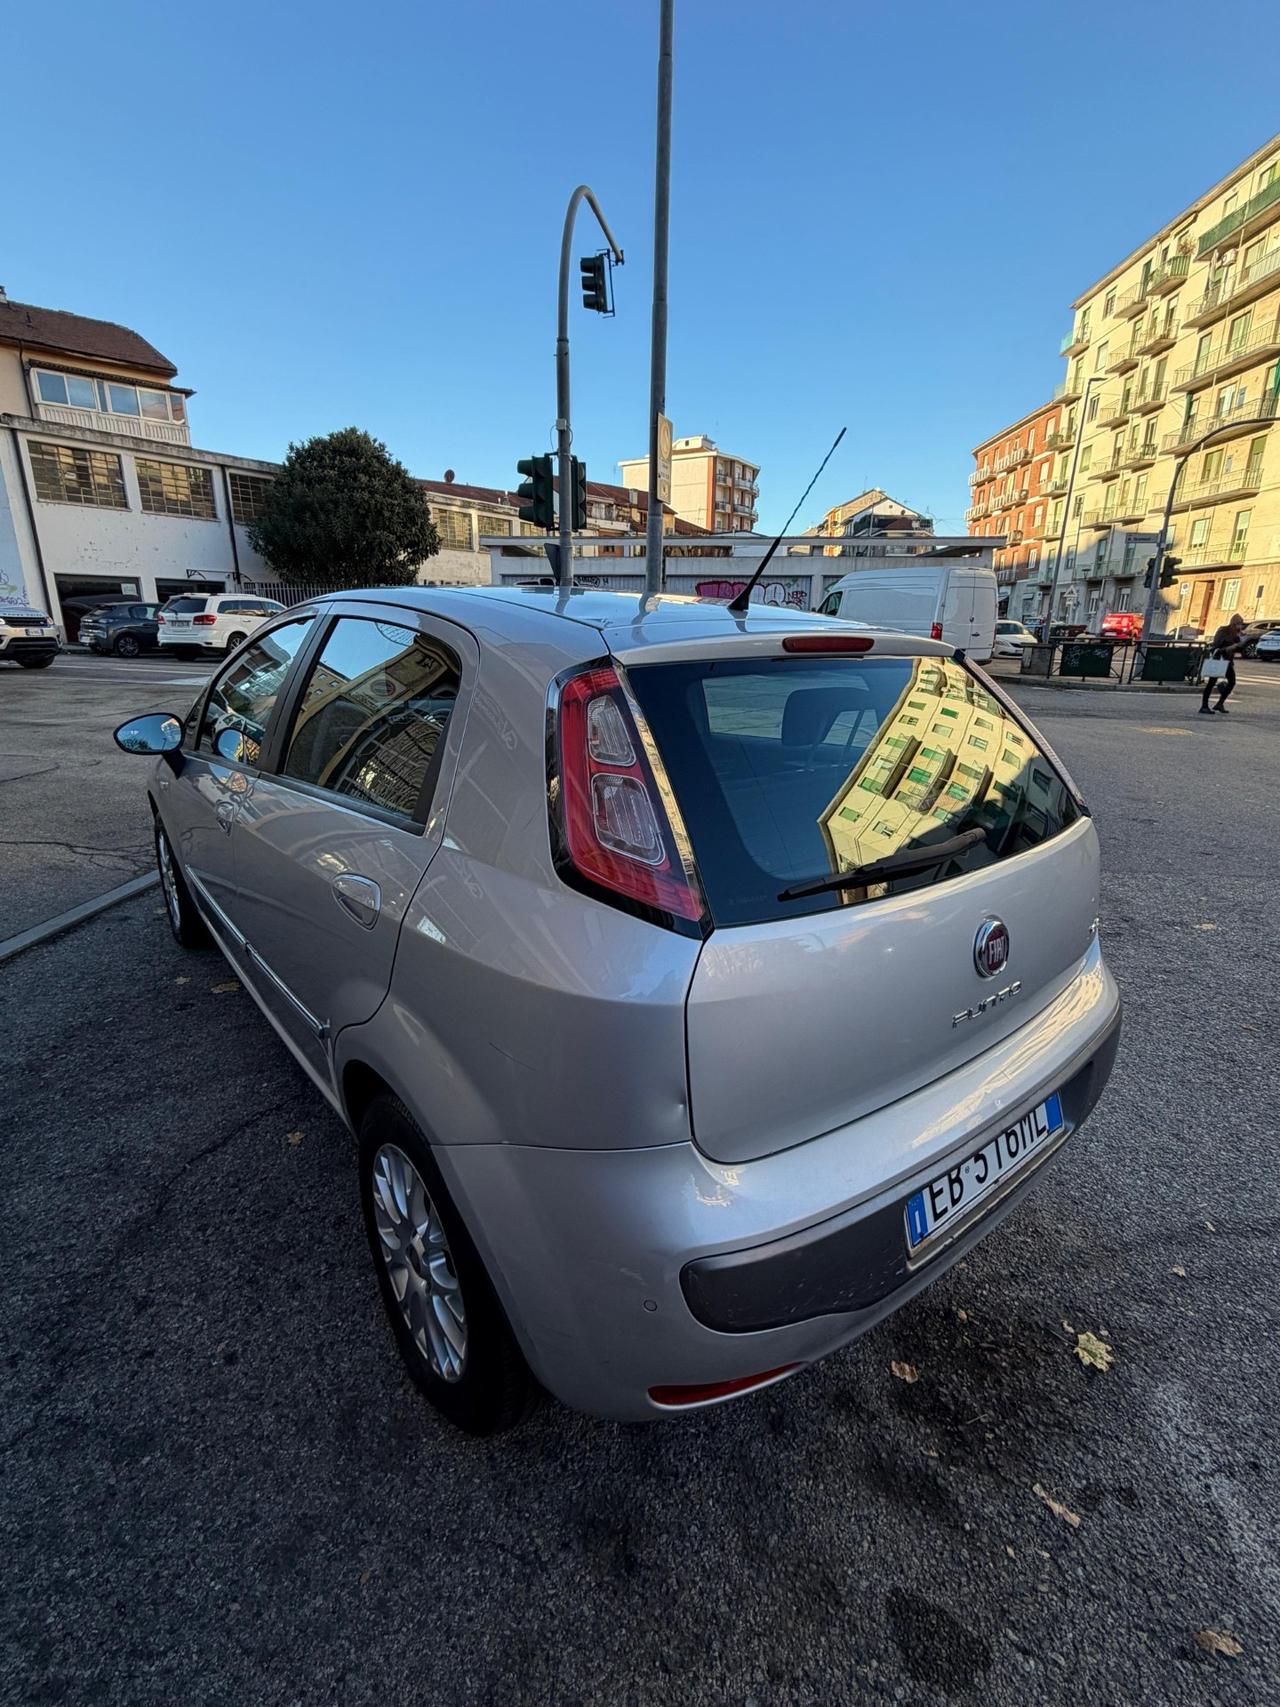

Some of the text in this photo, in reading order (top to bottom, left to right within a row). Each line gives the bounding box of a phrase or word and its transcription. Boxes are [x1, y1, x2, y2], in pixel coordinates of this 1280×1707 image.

[988, 935, 1007, 966] FIAT
[953, 981, 1021, 1029] PUNTO
[929, 1165, 964, 1222] EB
